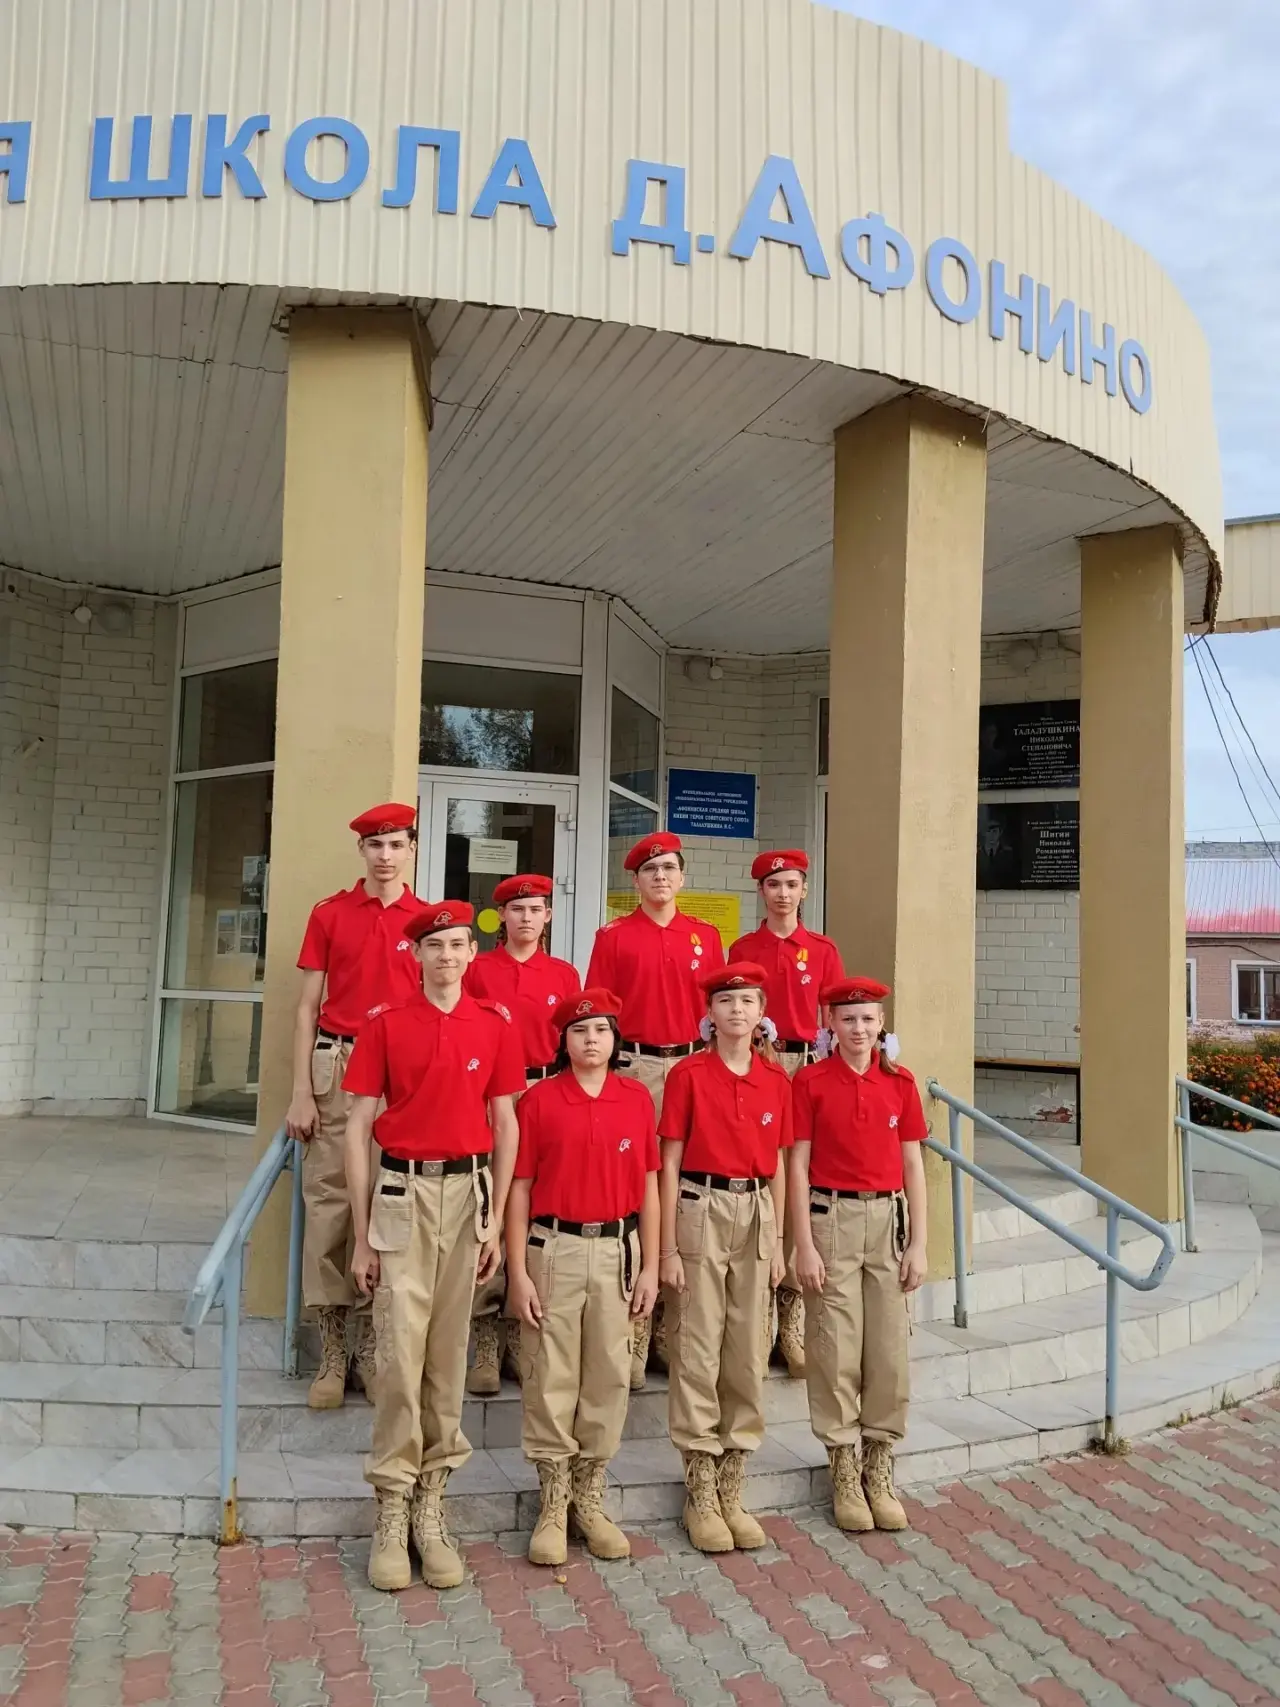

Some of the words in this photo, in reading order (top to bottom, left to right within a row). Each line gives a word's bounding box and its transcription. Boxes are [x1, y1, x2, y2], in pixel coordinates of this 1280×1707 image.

[89, 113, 557, 229] ШКОЛА
[1029, 735, 1064, 744] НИКОЛАЯ
[1021, 743, 1072, 752] СТЕПАНОВИЧА
[1040, 830, 1070, 838] Шигин
[1039, 839, 1071, 847] Николай
[1035, 847, 1075, 855] Романович
